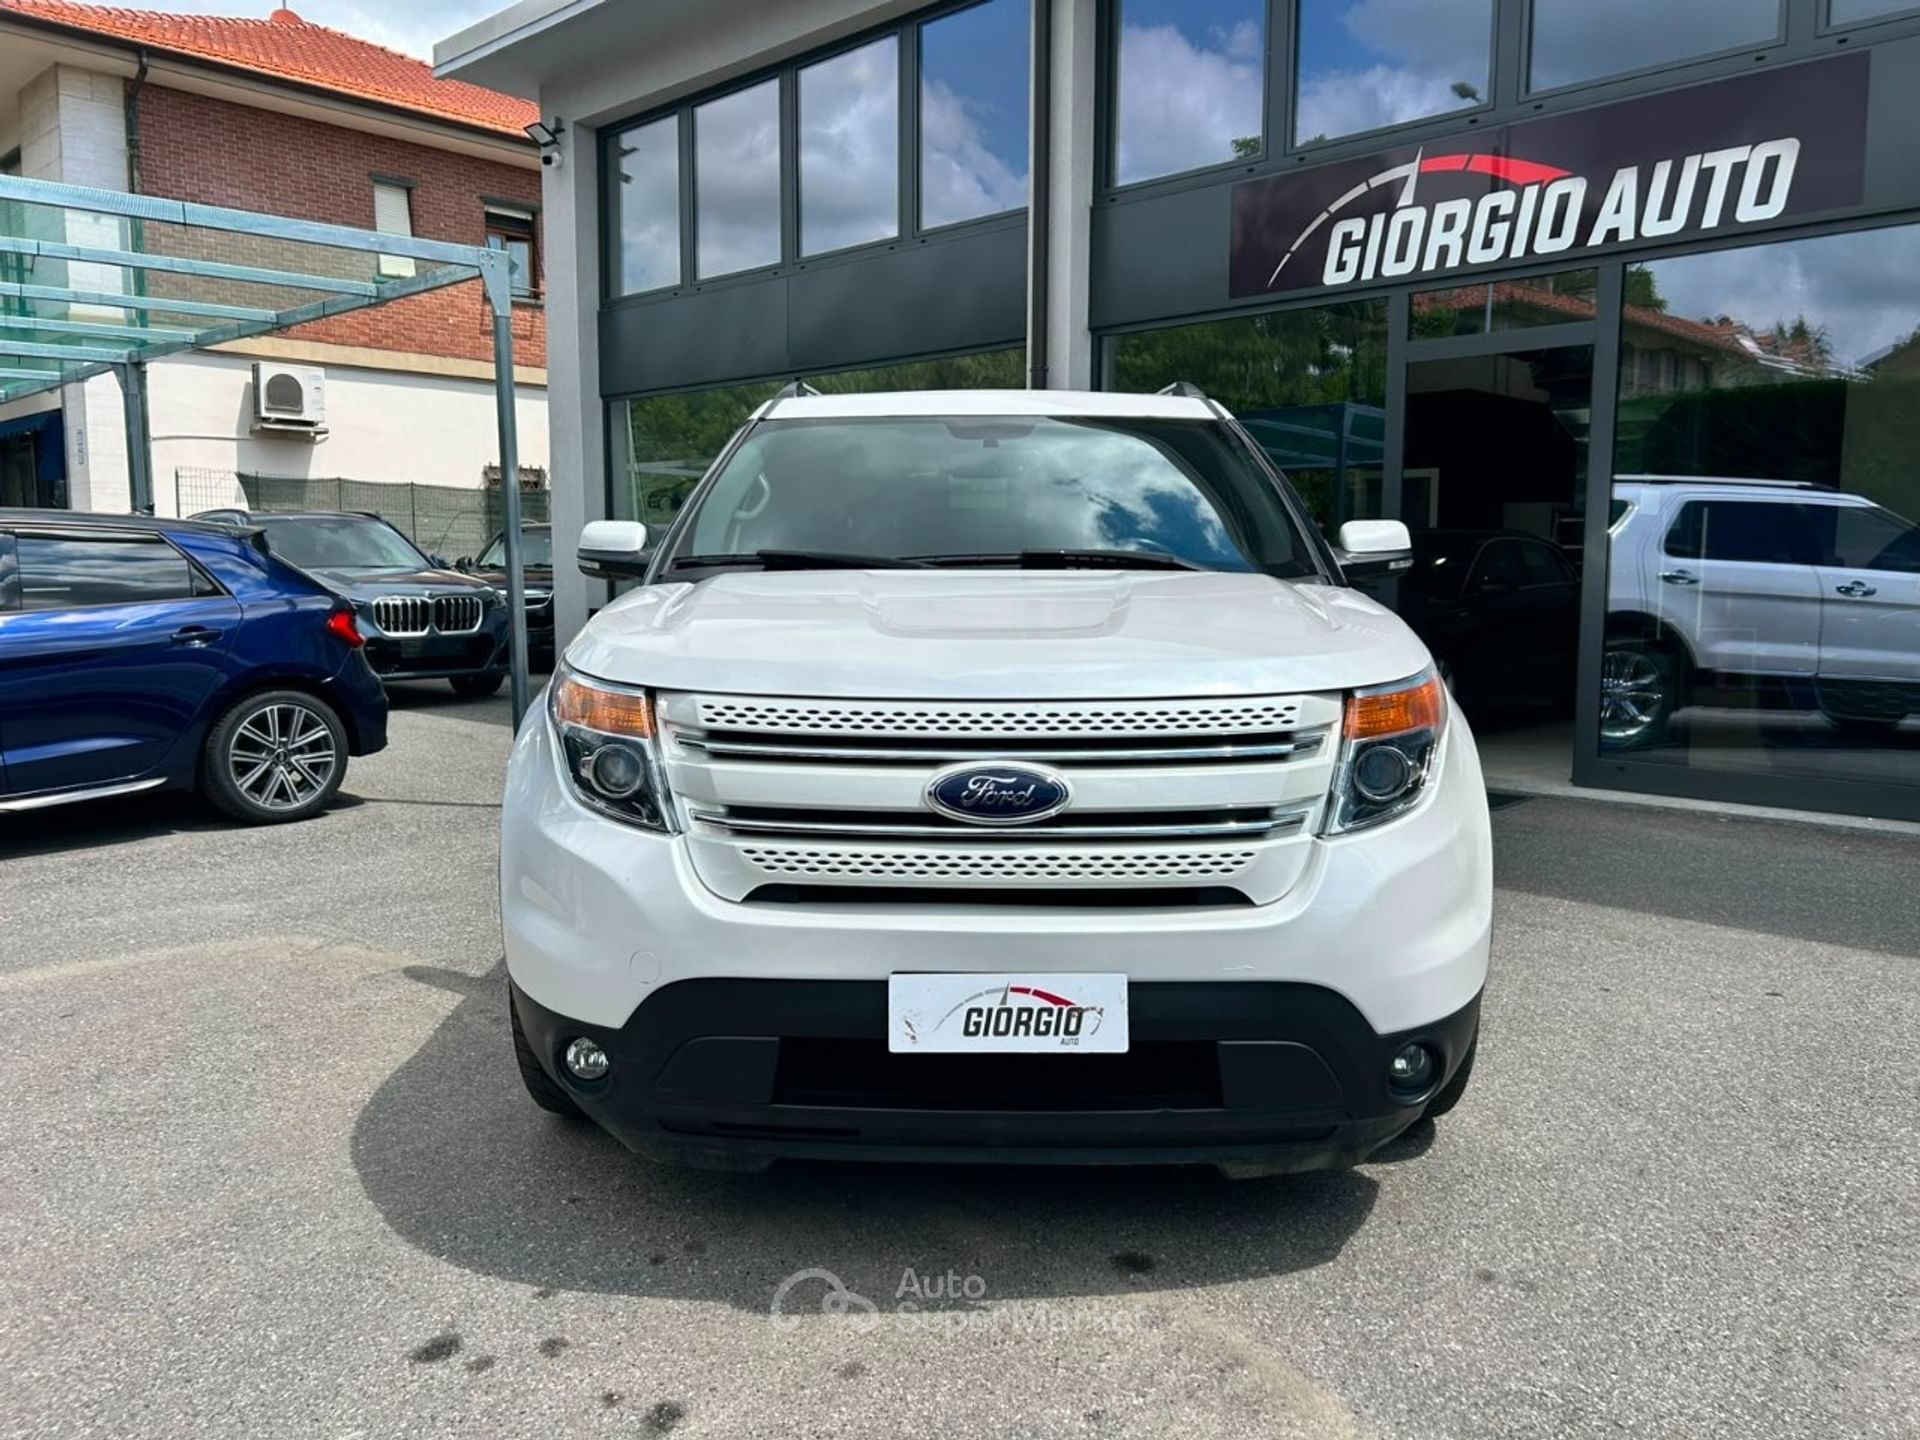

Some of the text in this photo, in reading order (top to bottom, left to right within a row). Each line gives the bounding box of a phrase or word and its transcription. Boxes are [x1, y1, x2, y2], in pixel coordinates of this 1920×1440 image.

[1323, 137, 1800, 286] GIORGIO AUTO
[960, 775, 1036, 807] Ford
[962, 1006, 1083, 1037] GIORGIO
[1060, 1037, 1080, 1046] AUTO
